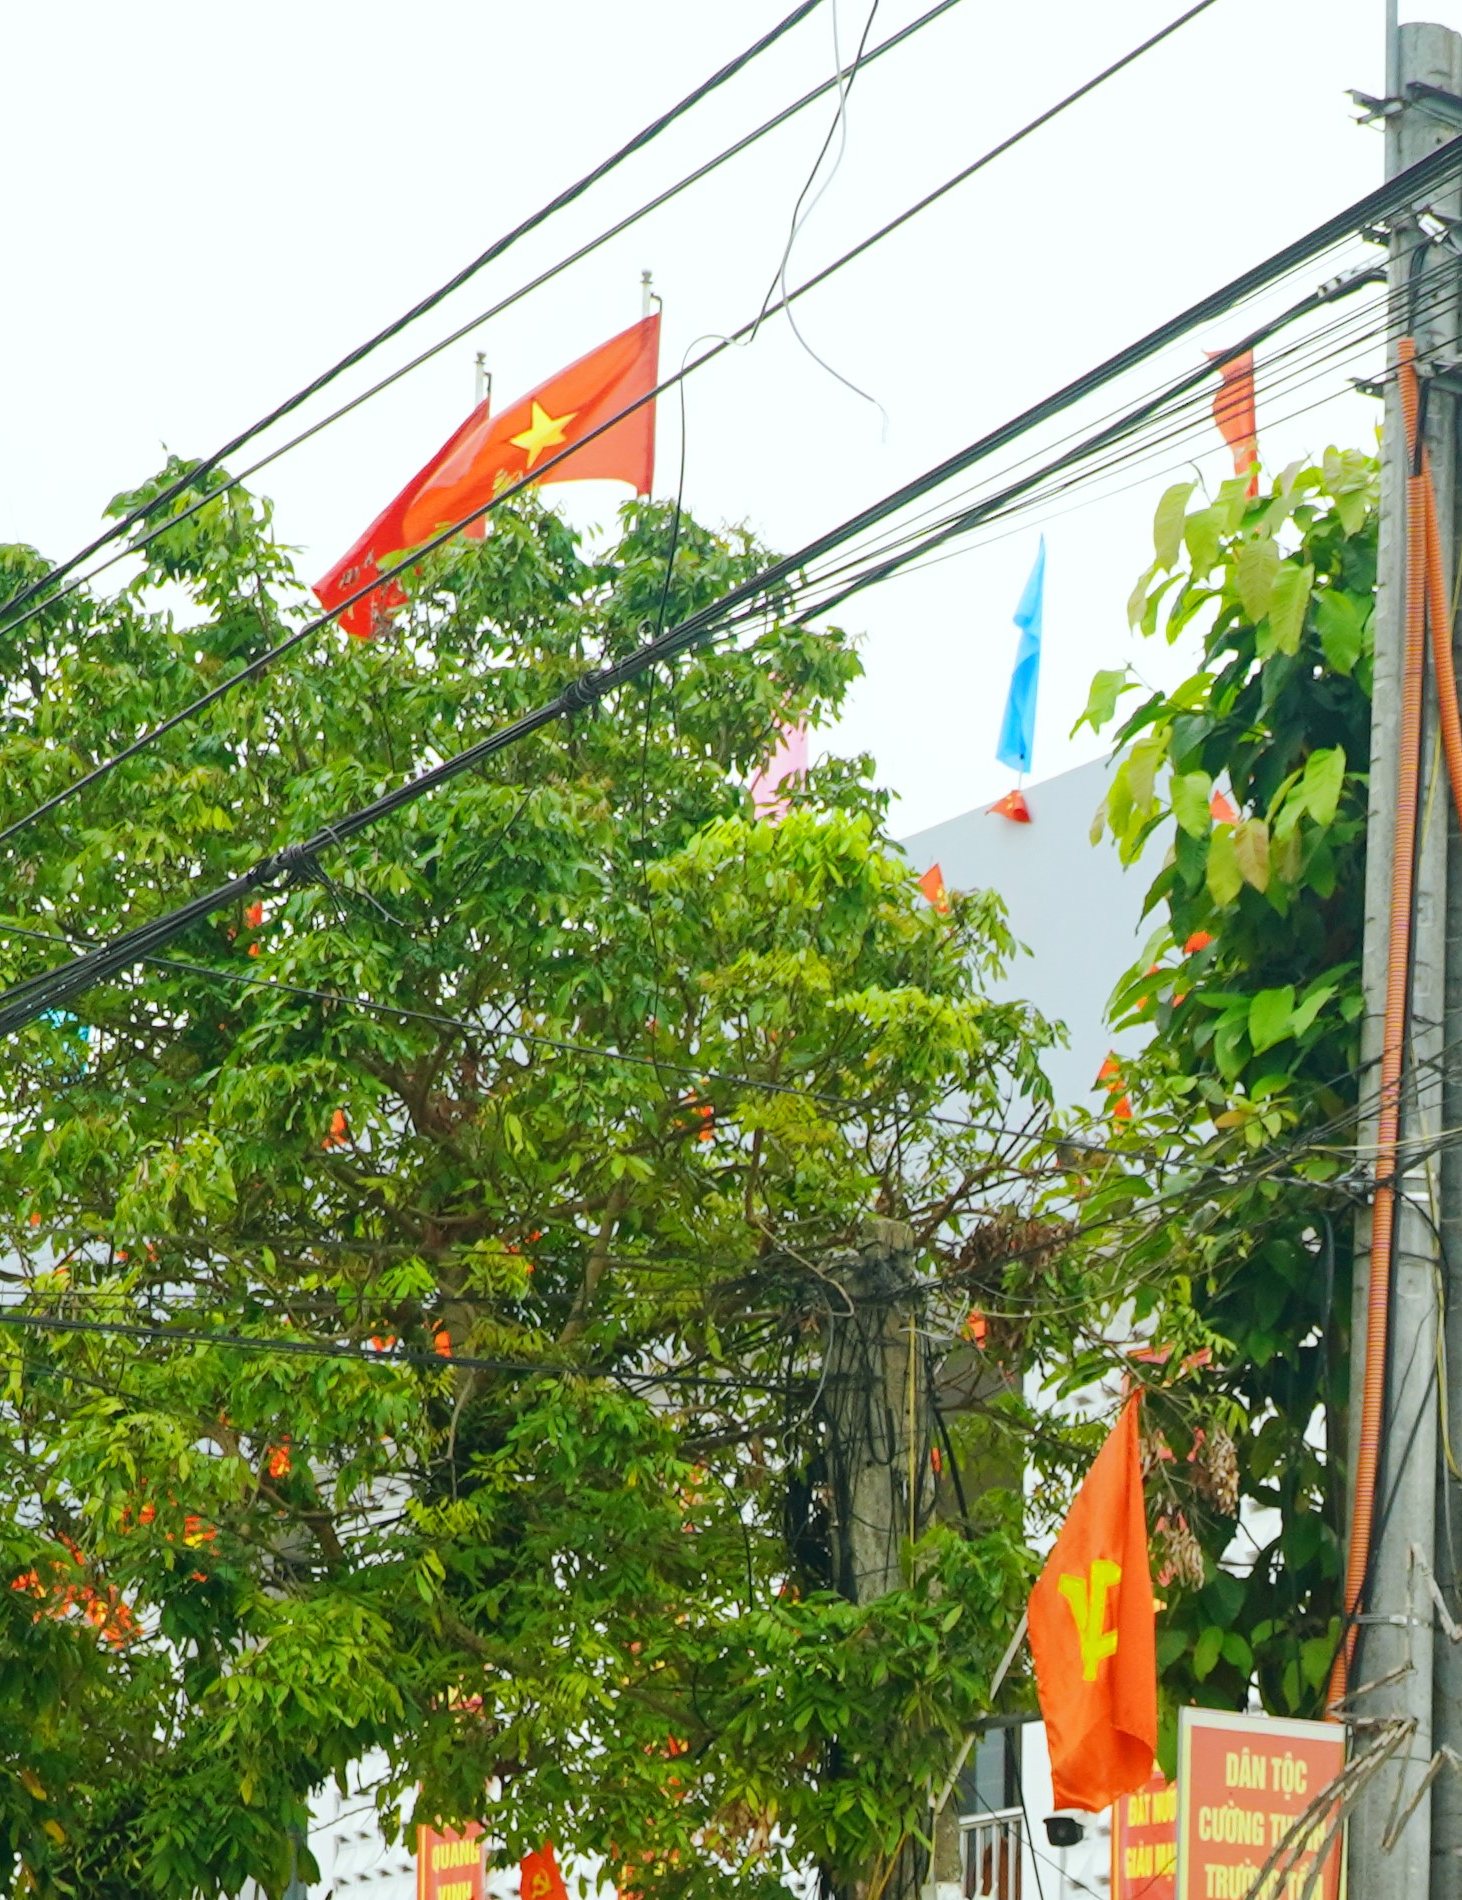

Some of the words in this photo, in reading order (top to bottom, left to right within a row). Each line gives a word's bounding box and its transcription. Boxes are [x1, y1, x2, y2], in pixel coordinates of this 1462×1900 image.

[1225, 1746, 1266, 1790] DÂN
[1270, 1752, 1308, 1800] TỘC
[1199, 1800, 1265, 1846] CƯỜNG
[432, 1838, 481, 1874] QUANG
